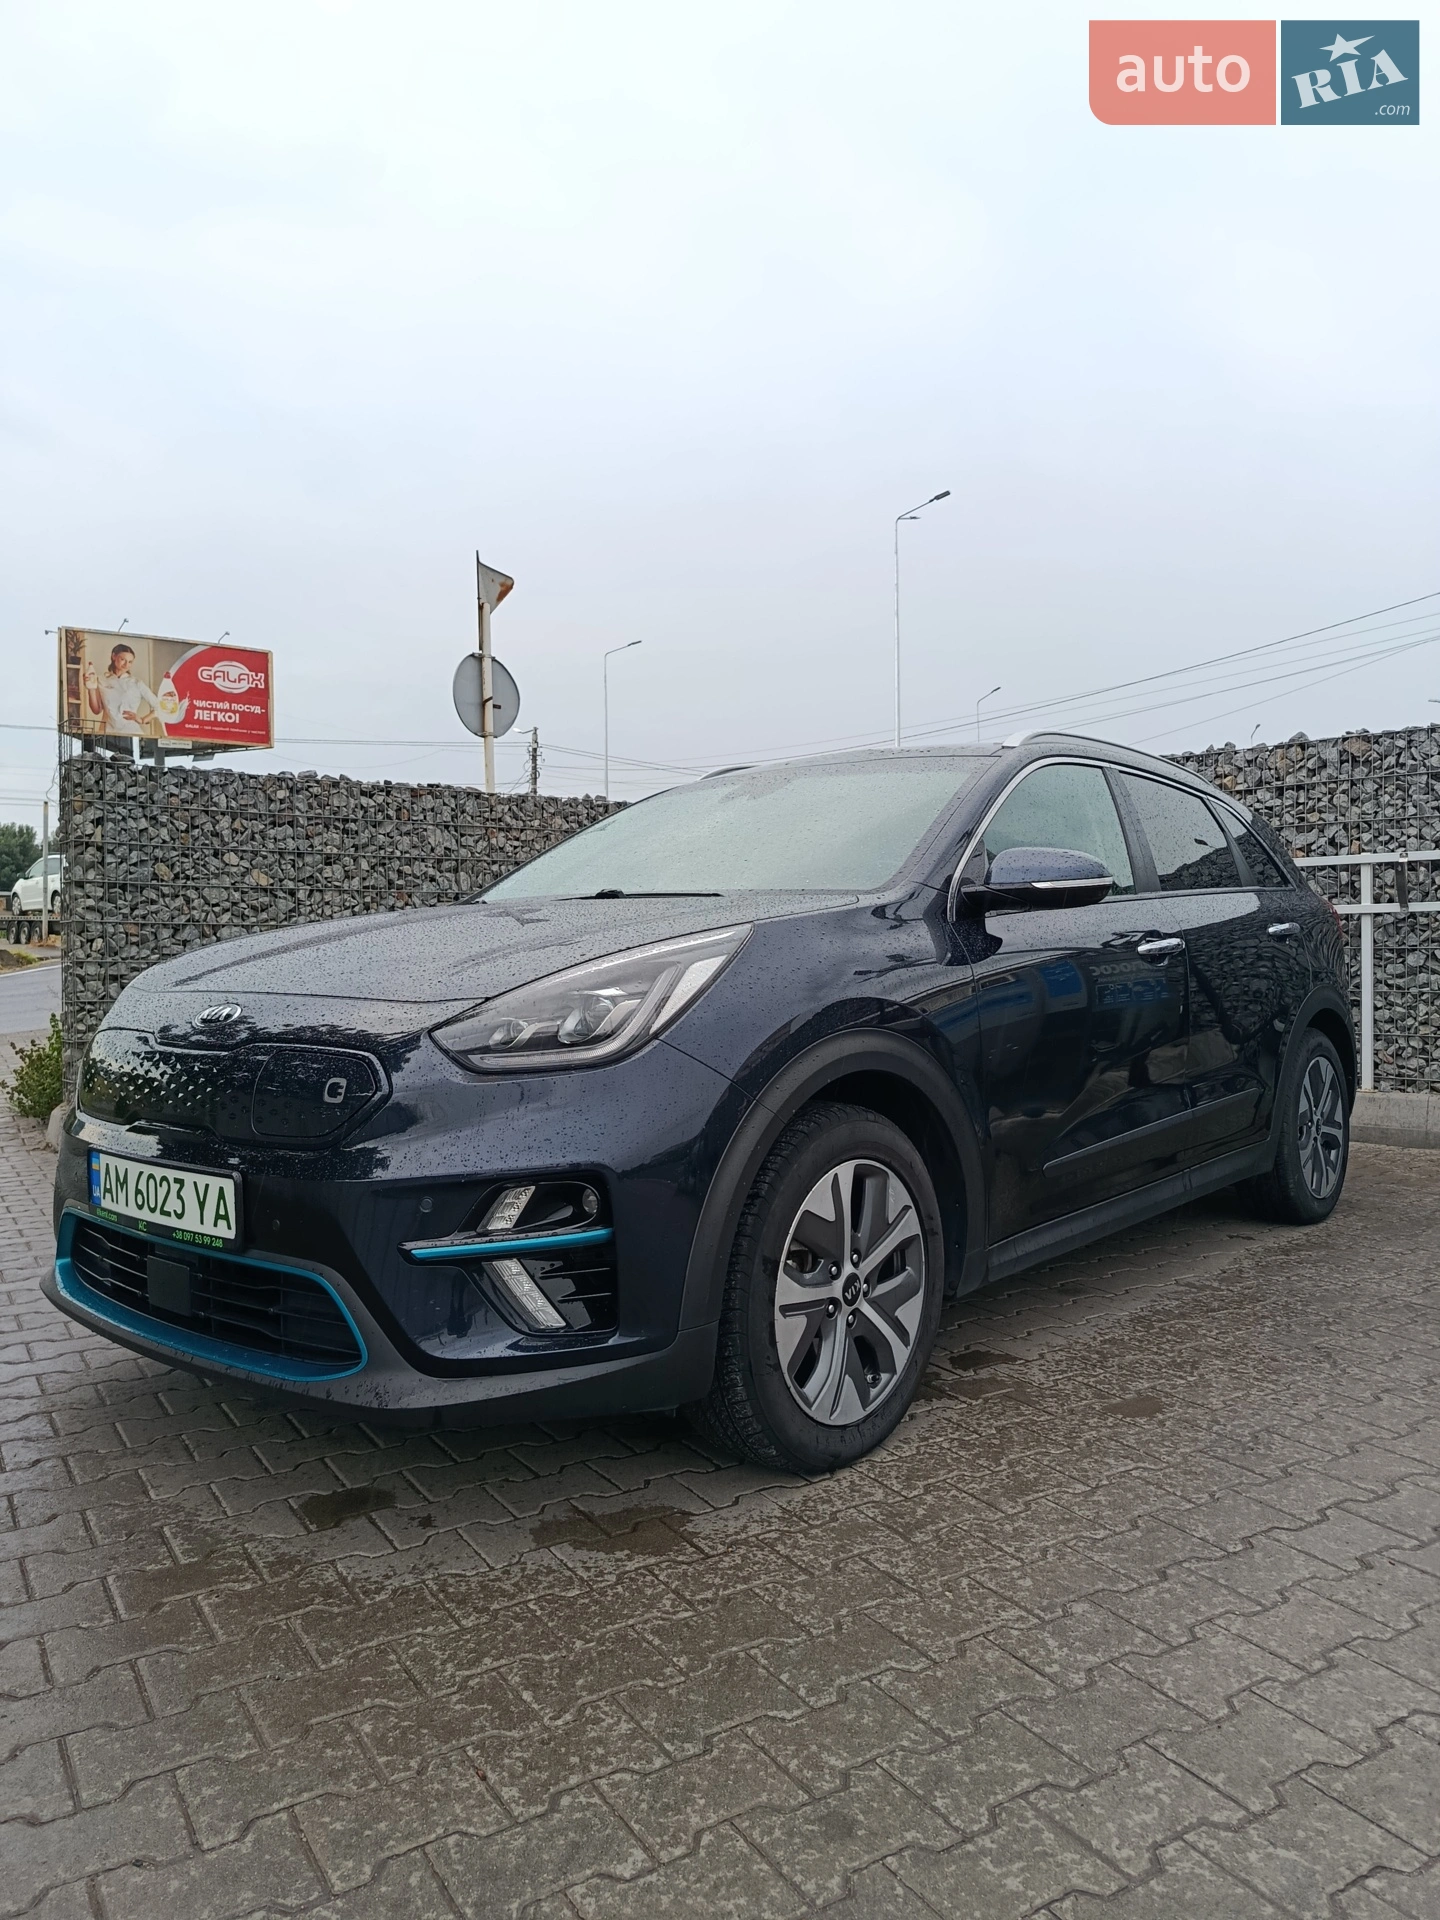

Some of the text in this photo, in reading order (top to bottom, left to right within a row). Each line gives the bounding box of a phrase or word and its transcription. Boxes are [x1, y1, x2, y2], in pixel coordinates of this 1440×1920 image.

[199, 666, 265, 689] GALAX
[193, 700, 230, 710] ЧИСТИЙ
[92, 1185, 100, 1198] UA
[102, 1163, 232, 1230] AM 6023 YA
[172, 1230, 223, 1248] +38 097 53 99 248
